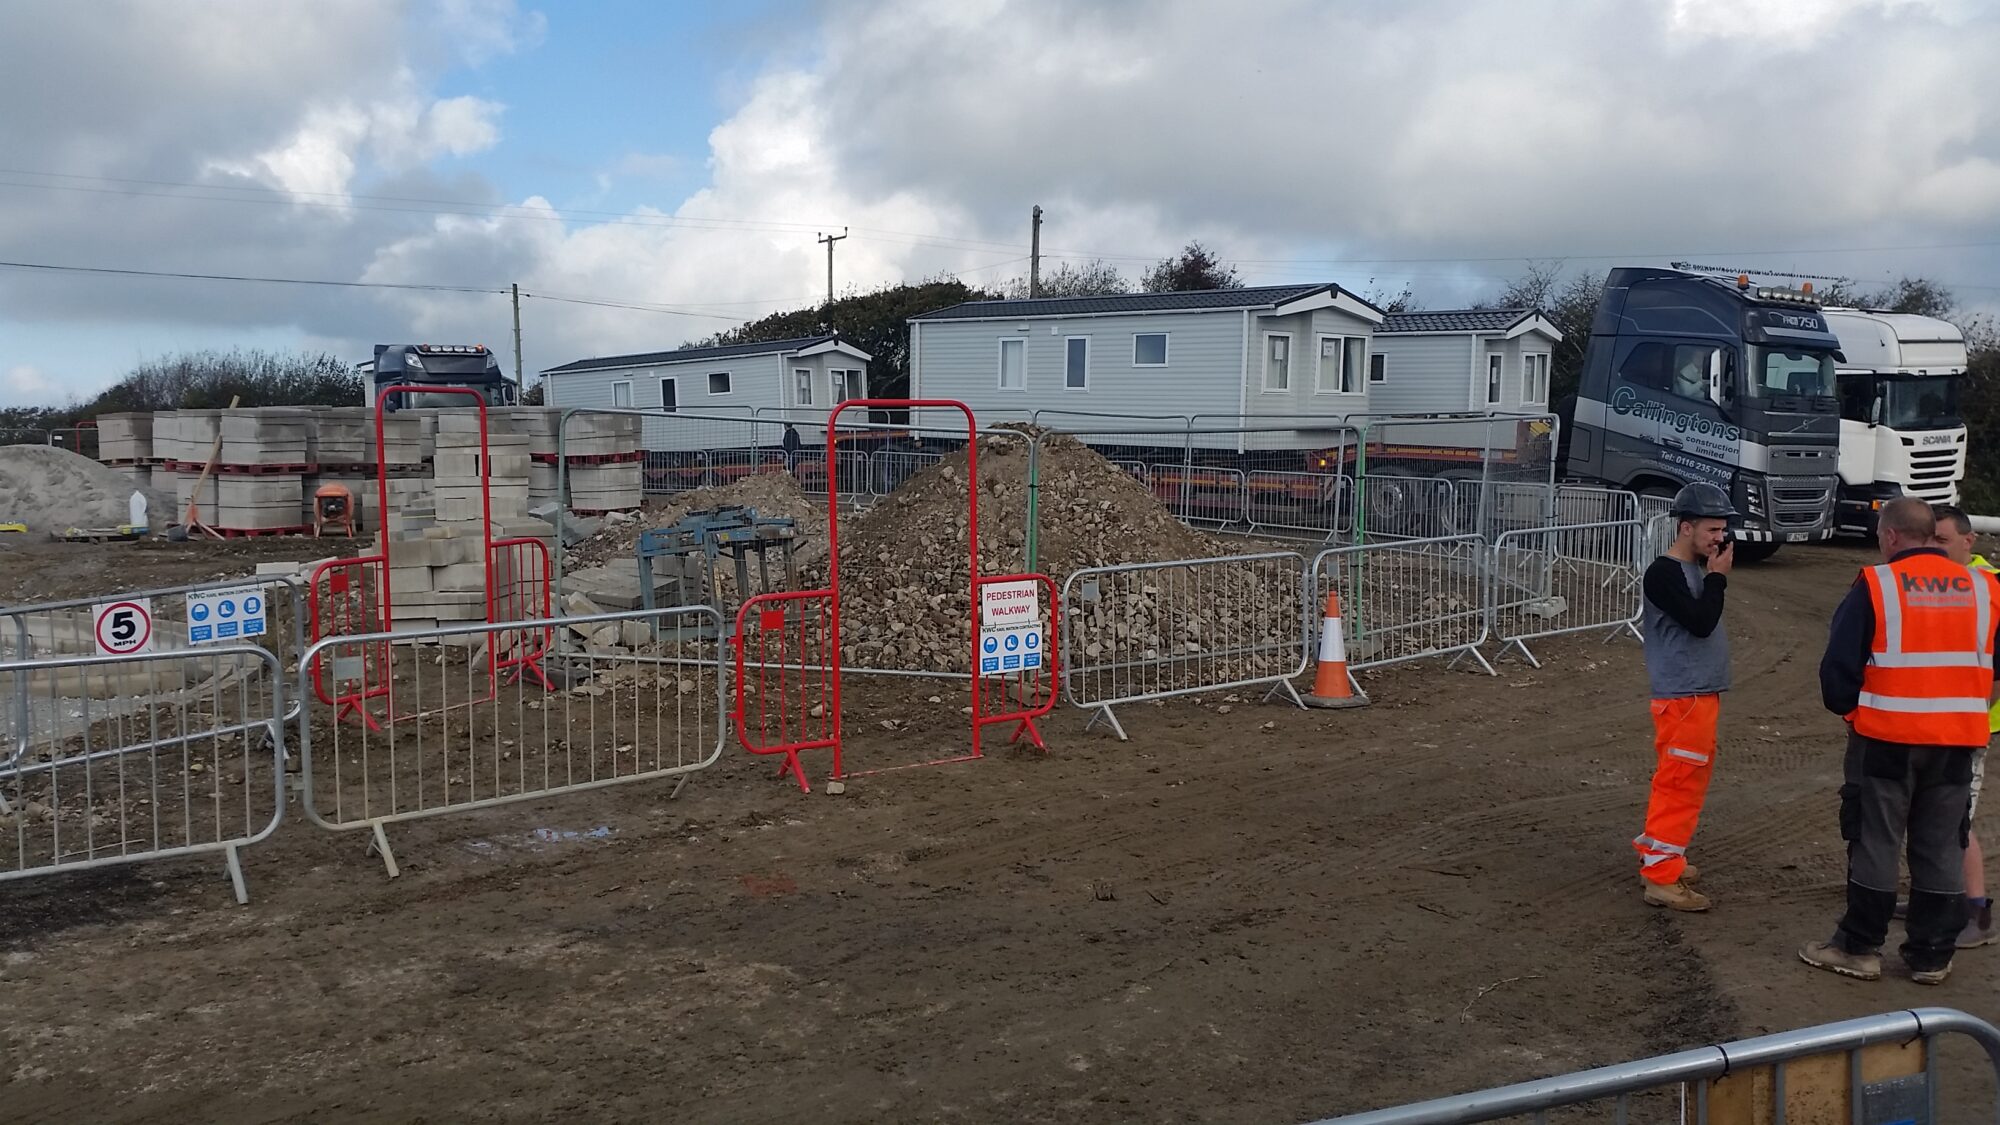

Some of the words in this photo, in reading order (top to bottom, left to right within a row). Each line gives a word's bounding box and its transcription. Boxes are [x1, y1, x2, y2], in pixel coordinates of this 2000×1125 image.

[1798, 316, 1819, 329] 750
[1612, 386, 1740, 441] Callingtons
[1685, 436, 1739, 455] construction
[1922, 435, 1951, 446] SCANIA
[1695, 446, 1725, 460] limited
[1661, 450, 1676, 462] Tel:
[1676, 456, 1695, 469] 0116
[1696, 462, 1711, 474] 235
[1711, 467, 1732, 480] 7100
[986, 589, 1035, 601] PEDESTRIAN
[991, 605, 1031, 617] WALKWAY
[111, 611, 136, 640] 5
[114, 639, 137, 647] MPH
